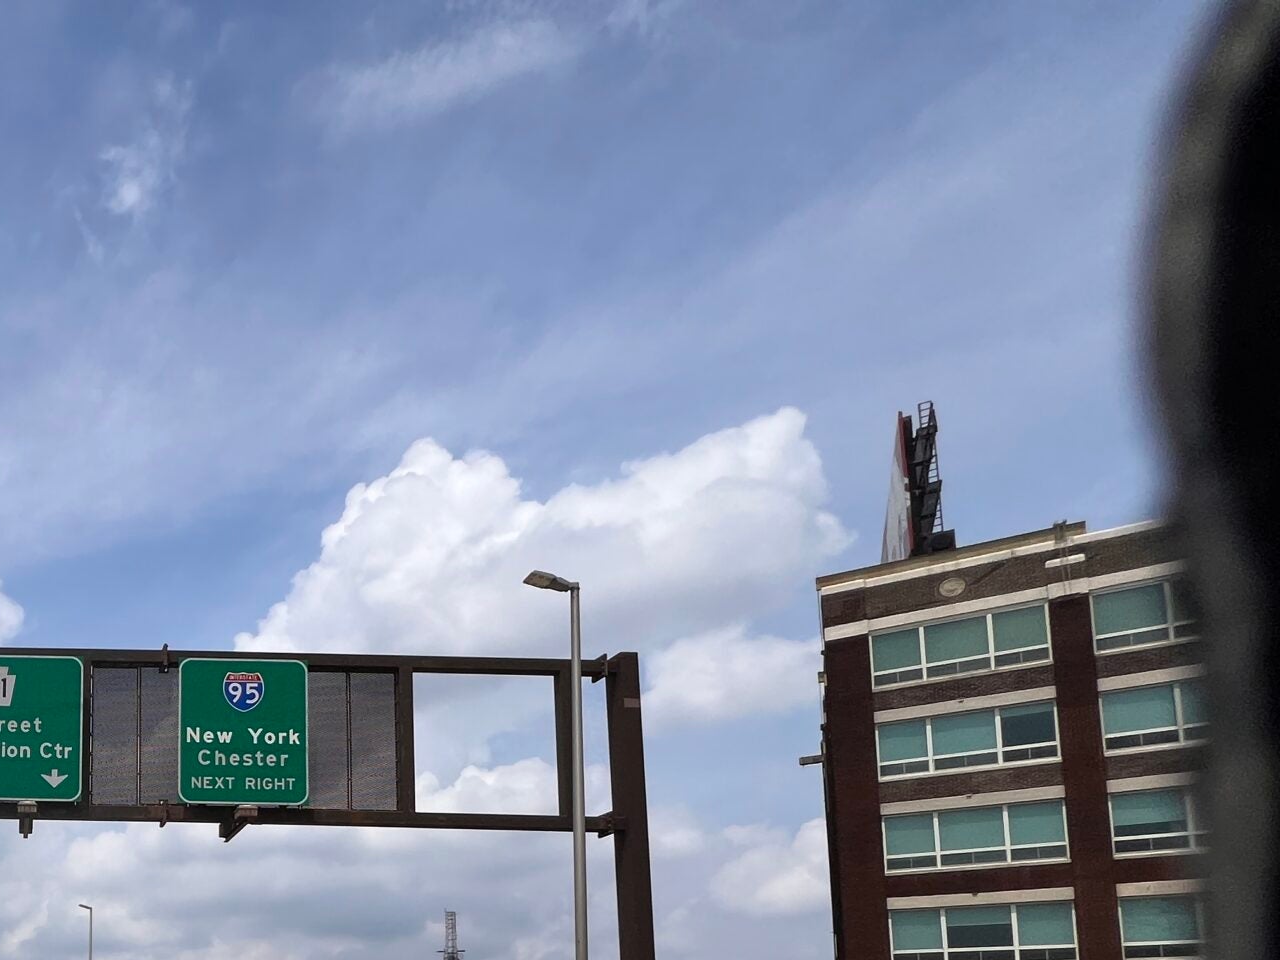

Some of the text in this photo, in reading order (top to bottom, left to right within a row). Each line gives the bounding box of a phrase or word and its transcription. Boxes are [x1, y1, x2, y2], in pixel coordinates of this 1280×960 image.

[228, 682, 260, 704] 95
[186, 726, 301, 745] New York
[39, 742, 73, 759] Ctr
[197, 749, 289, 767] Chester
[191, 776, 296, 790] NEXT RIGHT
